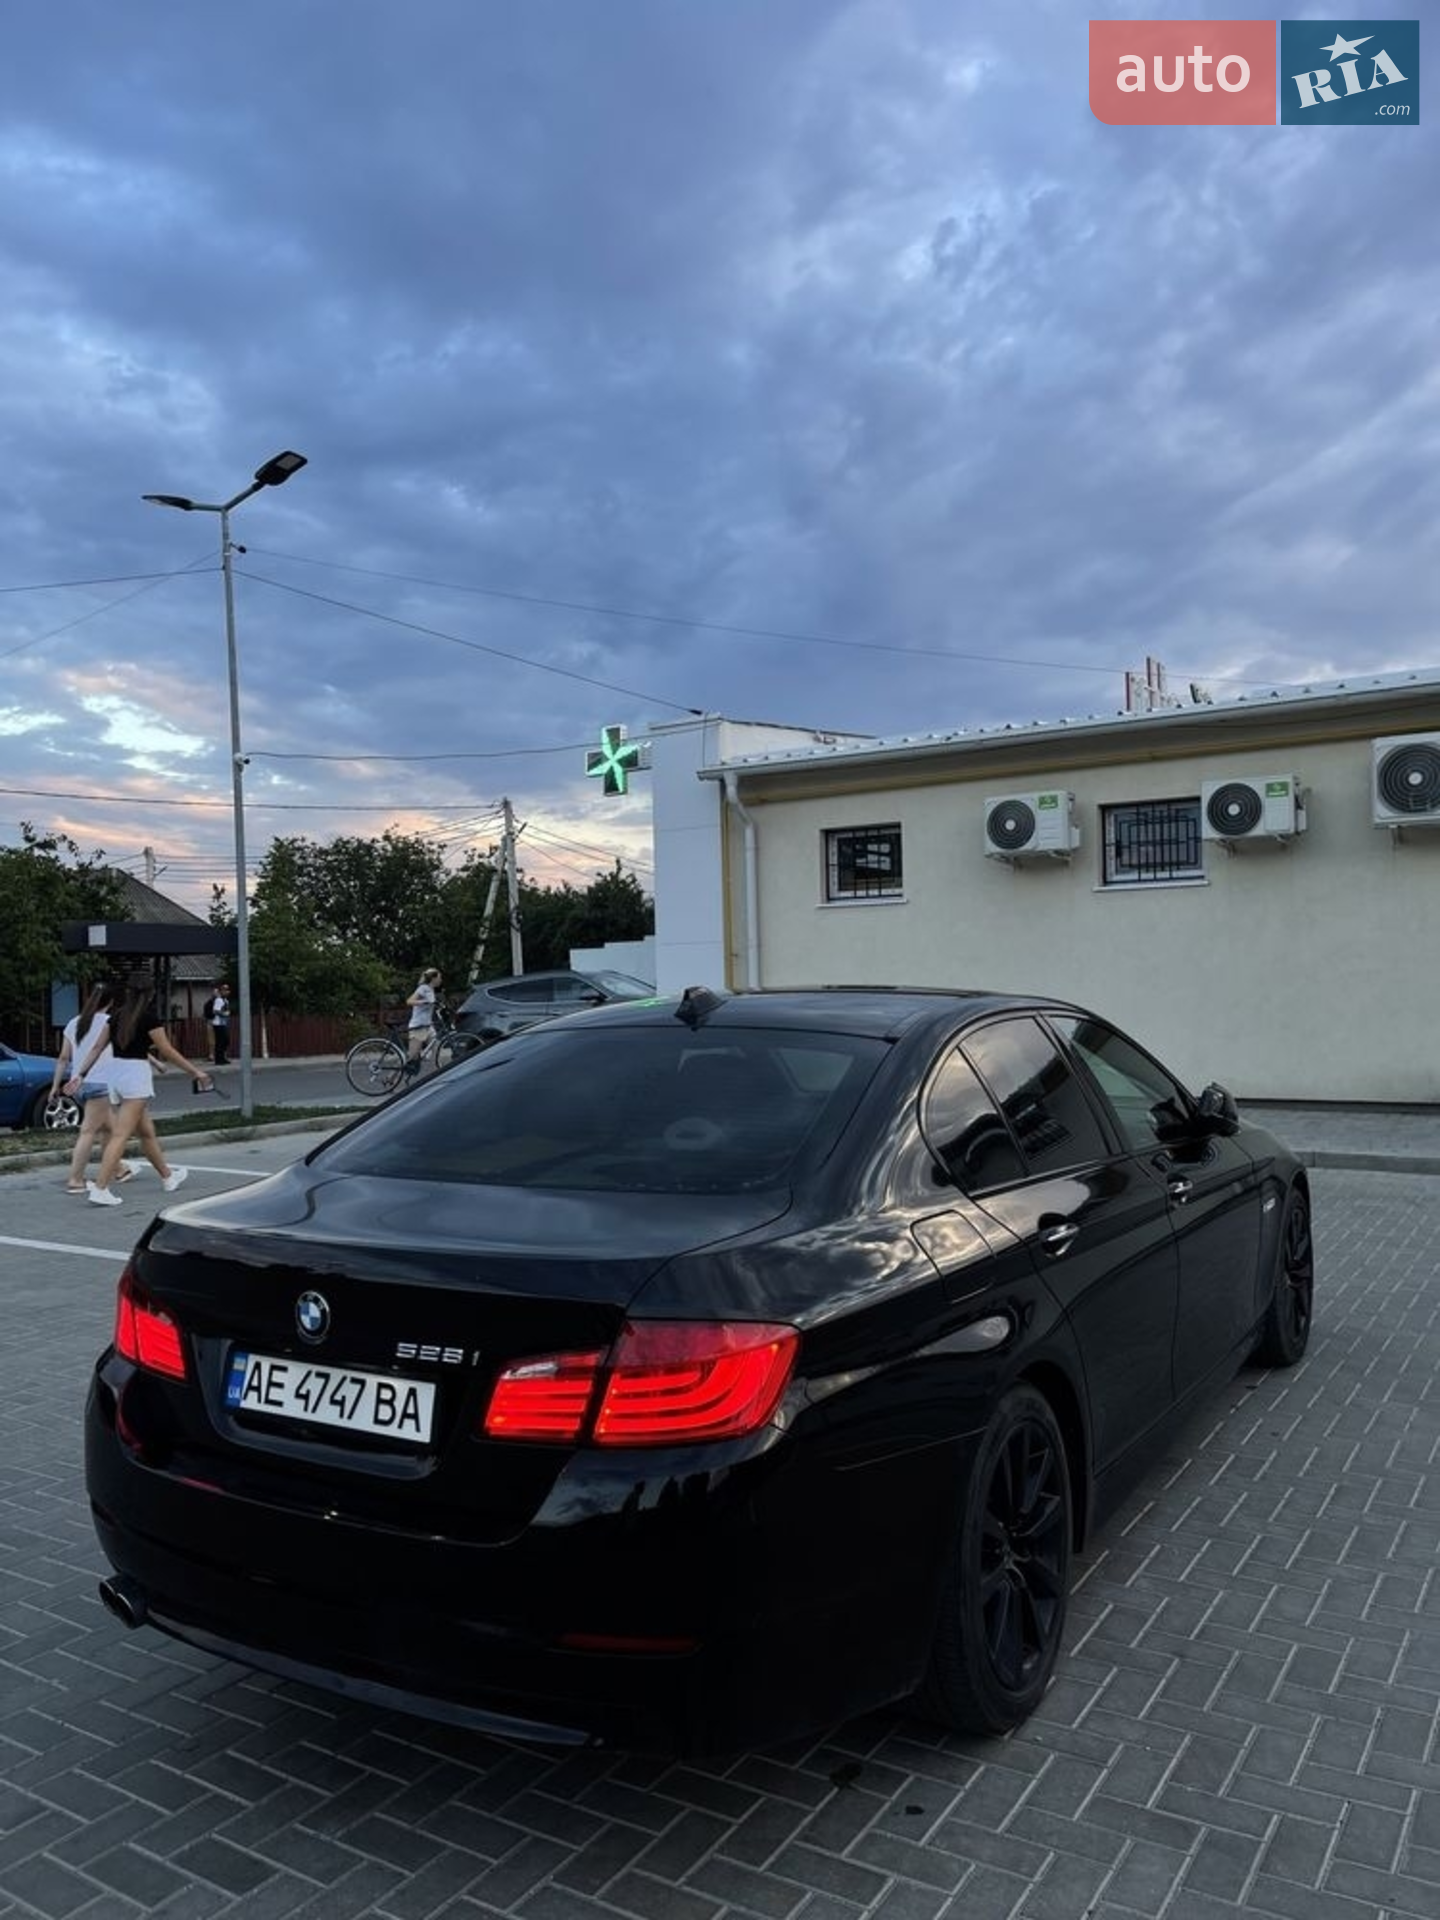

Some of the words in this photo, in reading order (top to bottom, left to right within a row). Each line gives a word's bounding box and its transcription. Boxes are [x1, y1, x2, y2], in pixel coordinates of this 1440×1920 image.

[243, 1360, 289, 1408] AE
[294, 1369, 367, 1420] 4747
[372, 1381, 421, 1433] BA
